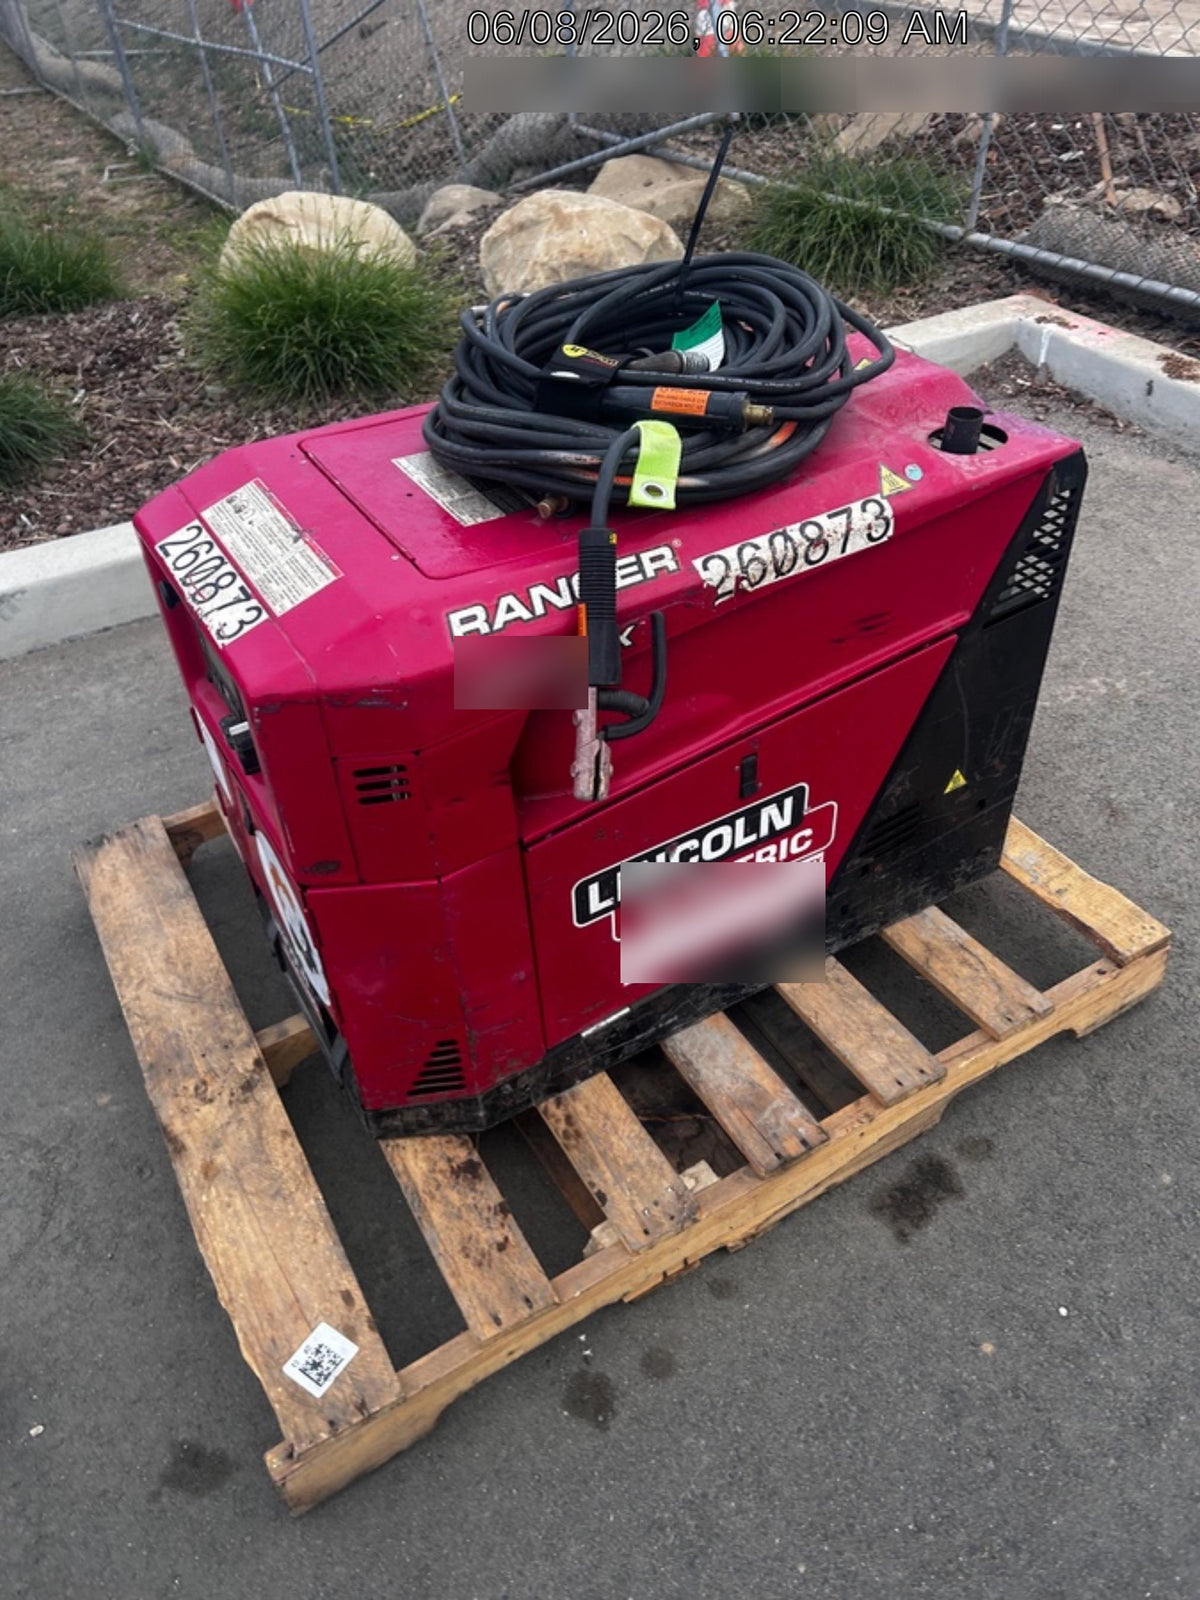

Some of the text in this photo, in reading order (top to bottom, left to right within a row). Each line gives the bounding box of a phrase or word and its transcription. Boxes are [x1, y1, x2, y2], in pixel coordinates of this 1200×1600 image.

[157, 524, 264, 642] 260873
[447, 546, 680, 637] RANER
[701, 497, 892, 602] 260873
[586, 795, 795, 915] LCOLN
